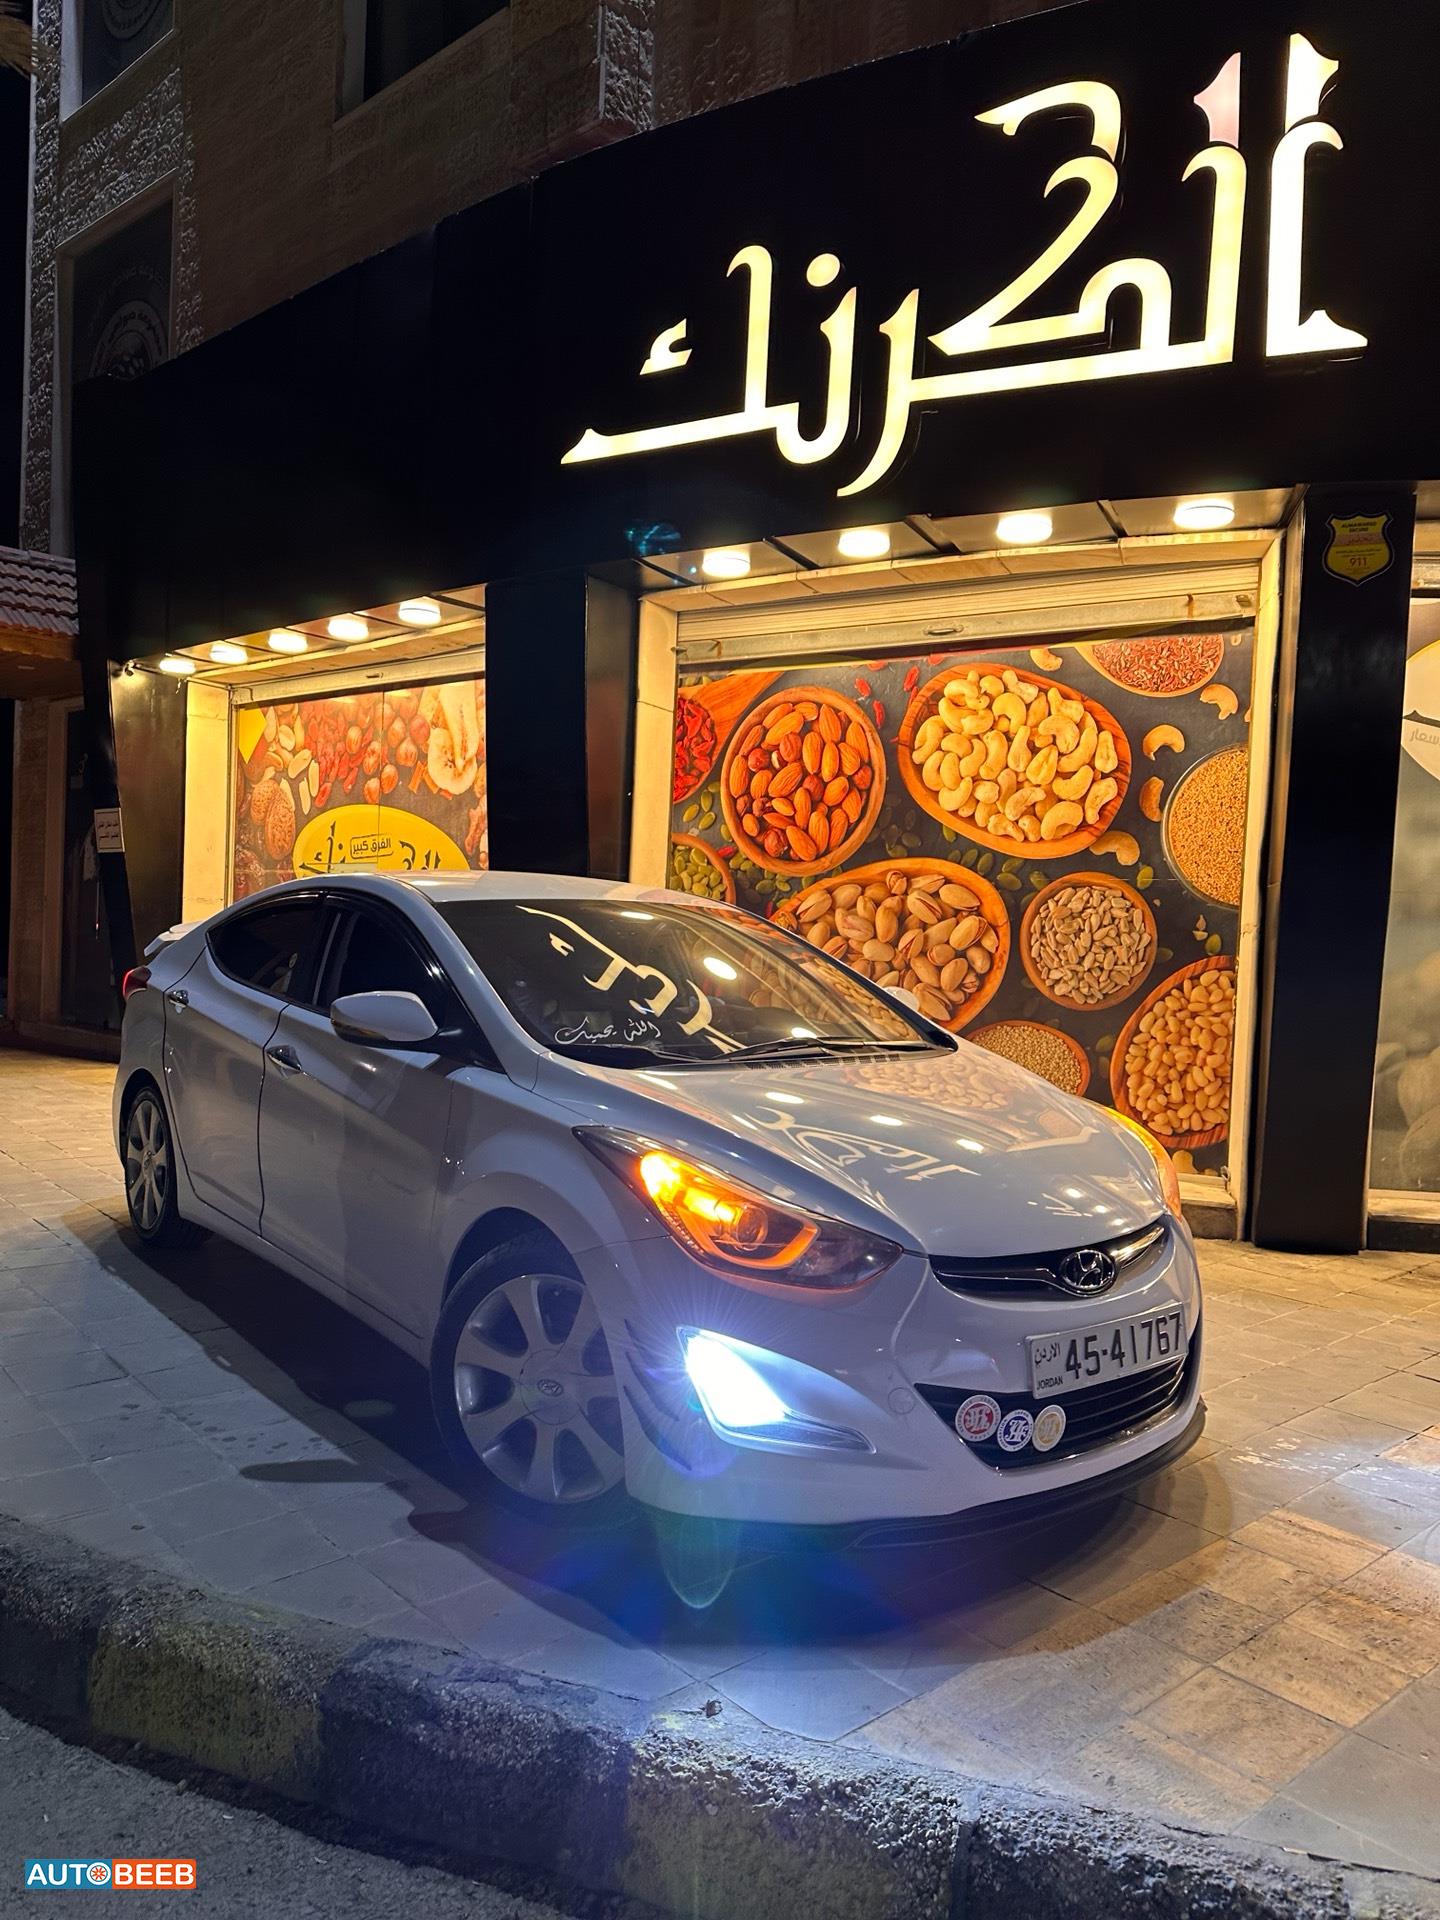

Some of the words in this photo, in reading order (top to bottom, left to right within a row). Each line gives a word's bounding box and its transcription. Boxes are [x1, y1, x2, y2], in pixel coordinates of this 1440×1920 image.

[1349, 557, 1367, 567] 911
[353, 840, 369, 856] كبير
[370, 837, 392, 853] الفرق
[1066, 1312, 1181, 1380] 45-41767
[1036, 1375, 1064, 1391] JORDAN
